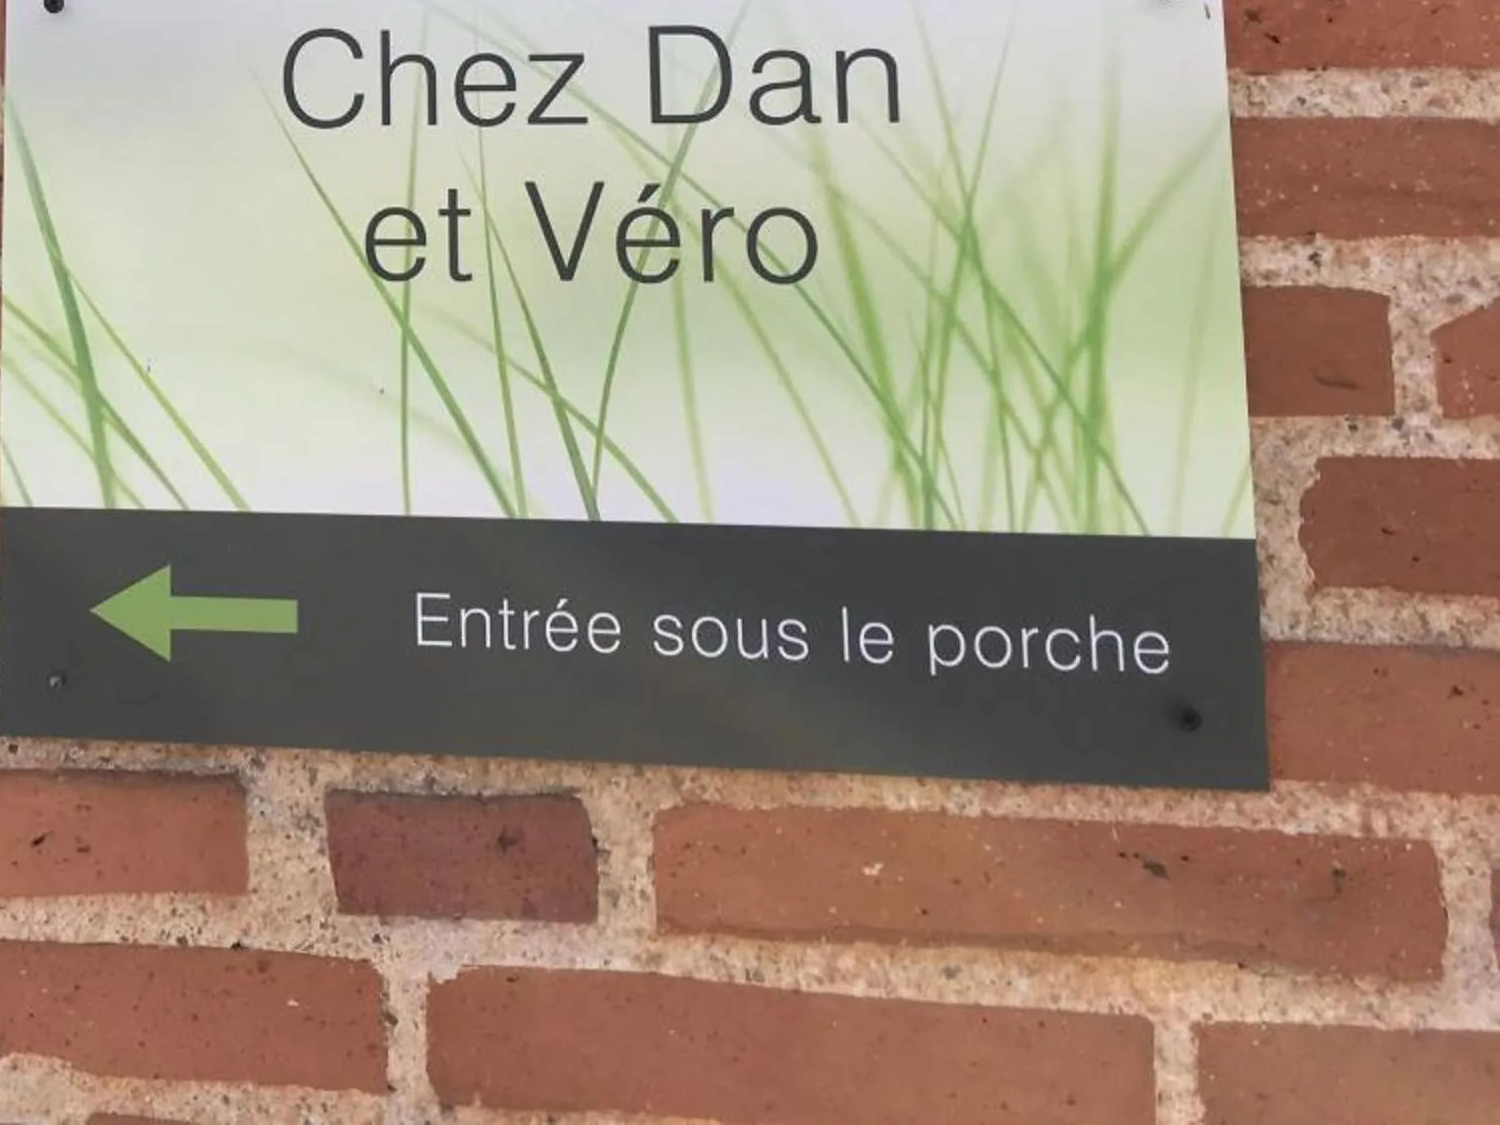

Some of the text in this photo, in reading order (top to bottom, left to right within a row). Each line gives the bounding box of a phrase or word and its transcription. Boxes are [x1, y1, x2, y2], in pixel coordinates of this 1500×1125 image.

[283, 25, 900, 130] Chez Dan
[365, 181, 818, 285] et Véro
[416, 592, 1170, 677] Entrée sous le porche
